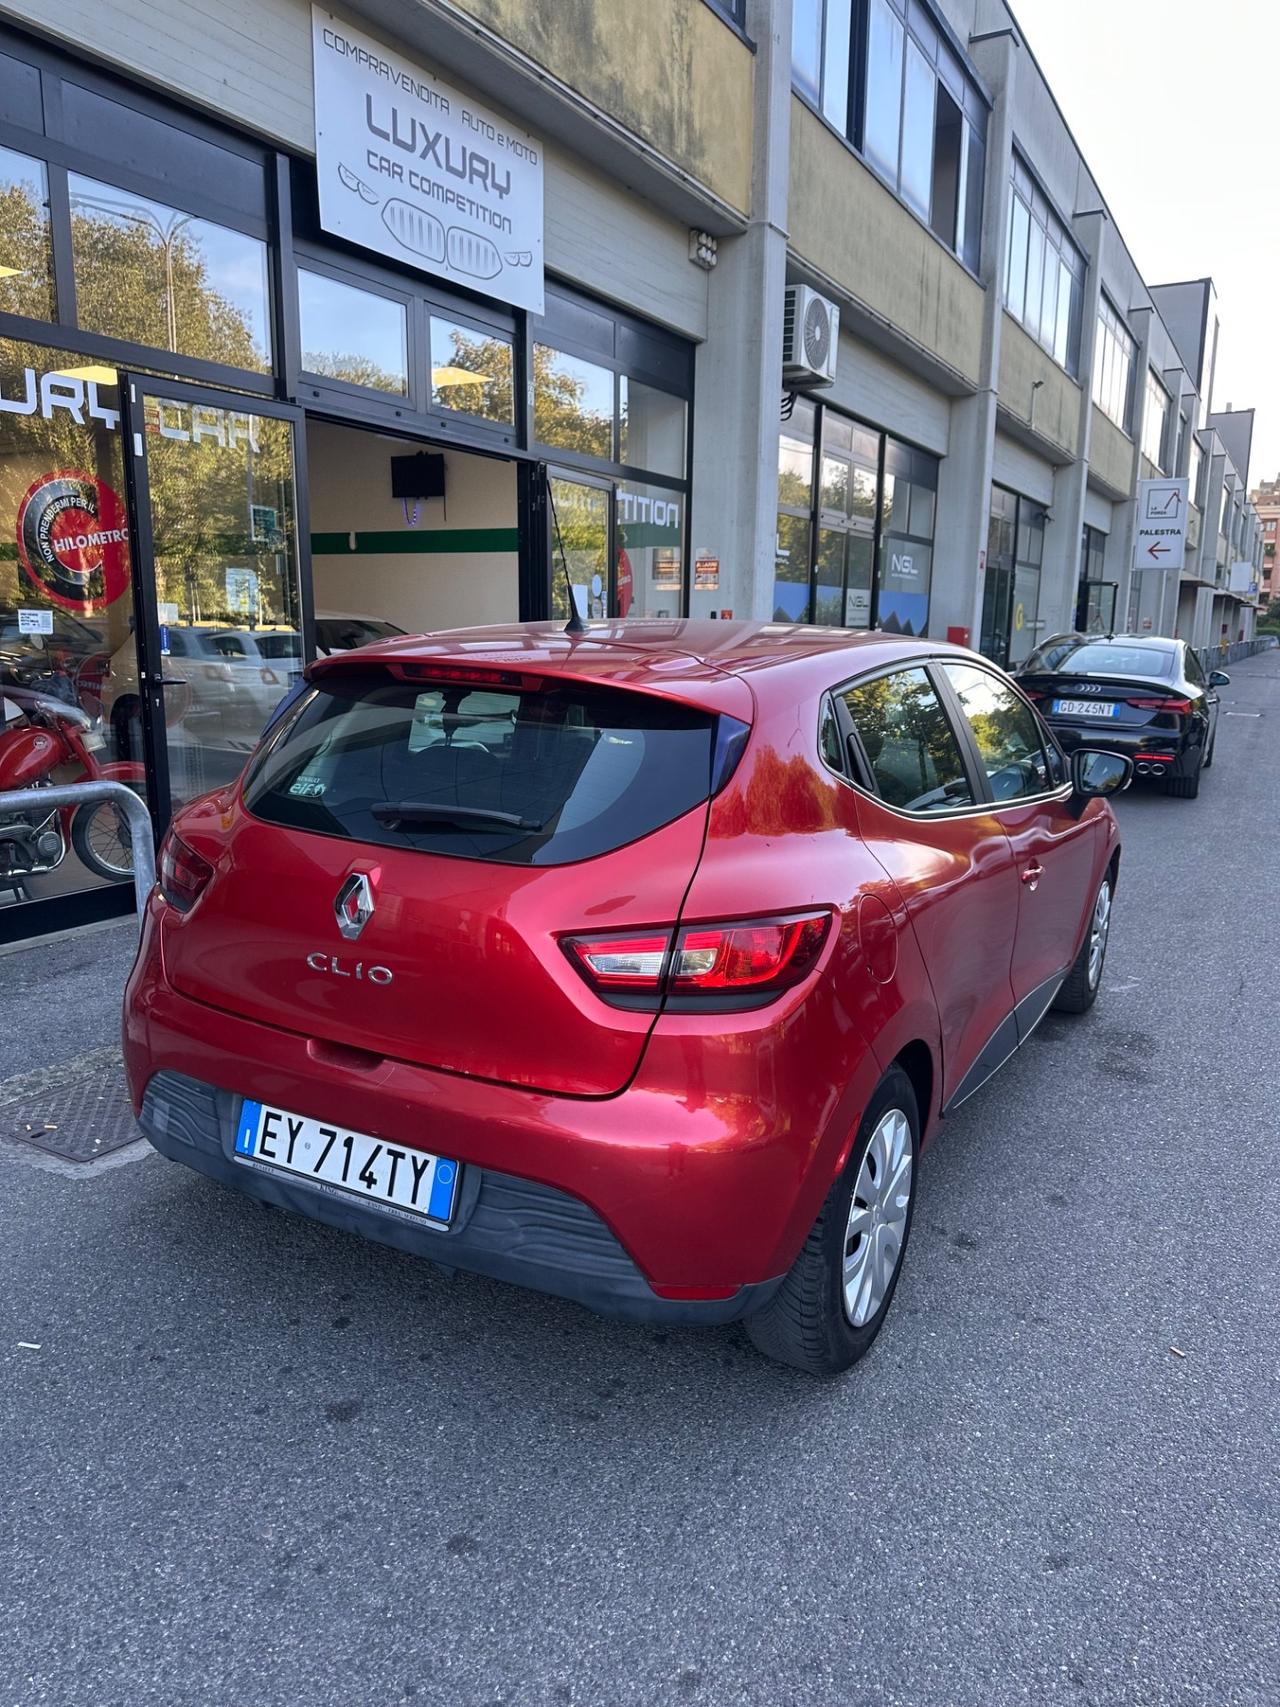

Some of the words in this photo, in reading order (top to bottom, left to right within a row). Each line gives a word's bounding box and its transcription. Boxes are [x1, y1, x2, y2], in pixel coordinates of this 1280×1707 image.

[323, 28, 450, 115] COMPRAVENDITA
[462, 110, 494, 139] AUTO
[507, 136, 538, 165] MOTO
[366, 93, 511, 199] LUXURY
[367, 150, 404, 184] CAR
[410, 171, 512, 234] COMPETITION
[159, 400, 261, 453] CAR
[40, 497, 69, 540] PRENDERMI
[70, 496, 87, 509] PER
[88, 503, 95, 514] IL
[616, 489, 679, 528] TITION
[40, 542, 54, 563] NON
[892, 553, 919, 574] NGL
[848, 595, 869, 608] NGL
[306, 951, 393, 985] CLIO
[259, 1111, 304, 1164] EY
[313, 1127, 430, 1205] 714TY
